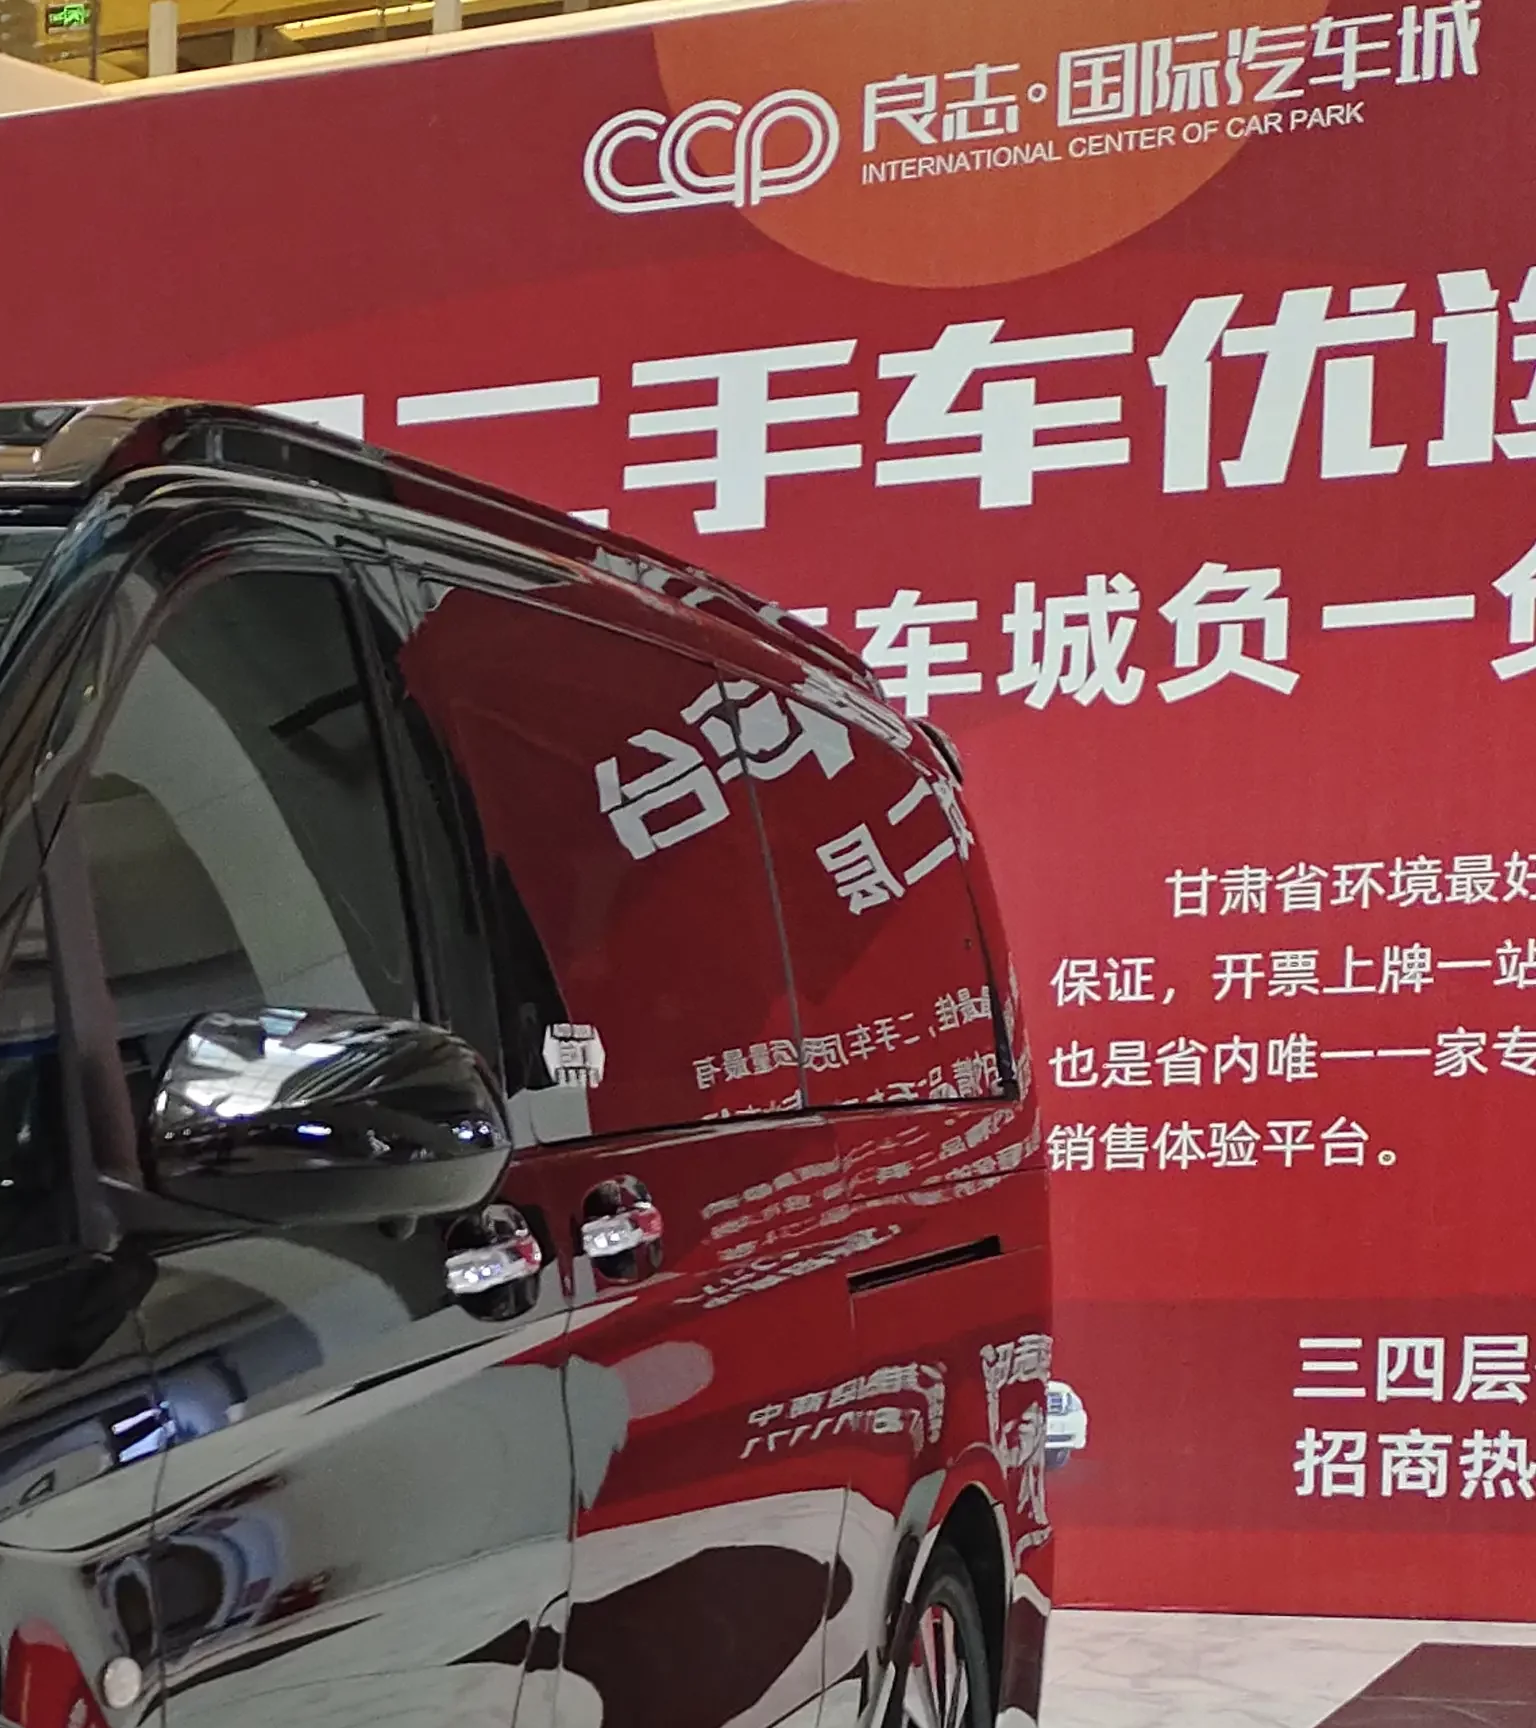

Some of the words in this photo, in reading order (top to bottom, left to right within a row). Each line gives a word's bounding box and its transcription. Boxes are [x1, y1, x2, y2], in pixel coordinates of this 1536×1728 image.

[862, 141, 1063, 186] INTERNATIONAL
[1068, 125, 1176, 159] CENTER
[1182, 120, 1219, 145] OF
[1226, 112, 1283, 139] CAR
[1289, 101, 1365, 130] PARK
[1292, 1427, 1536, 1500] 招商热
